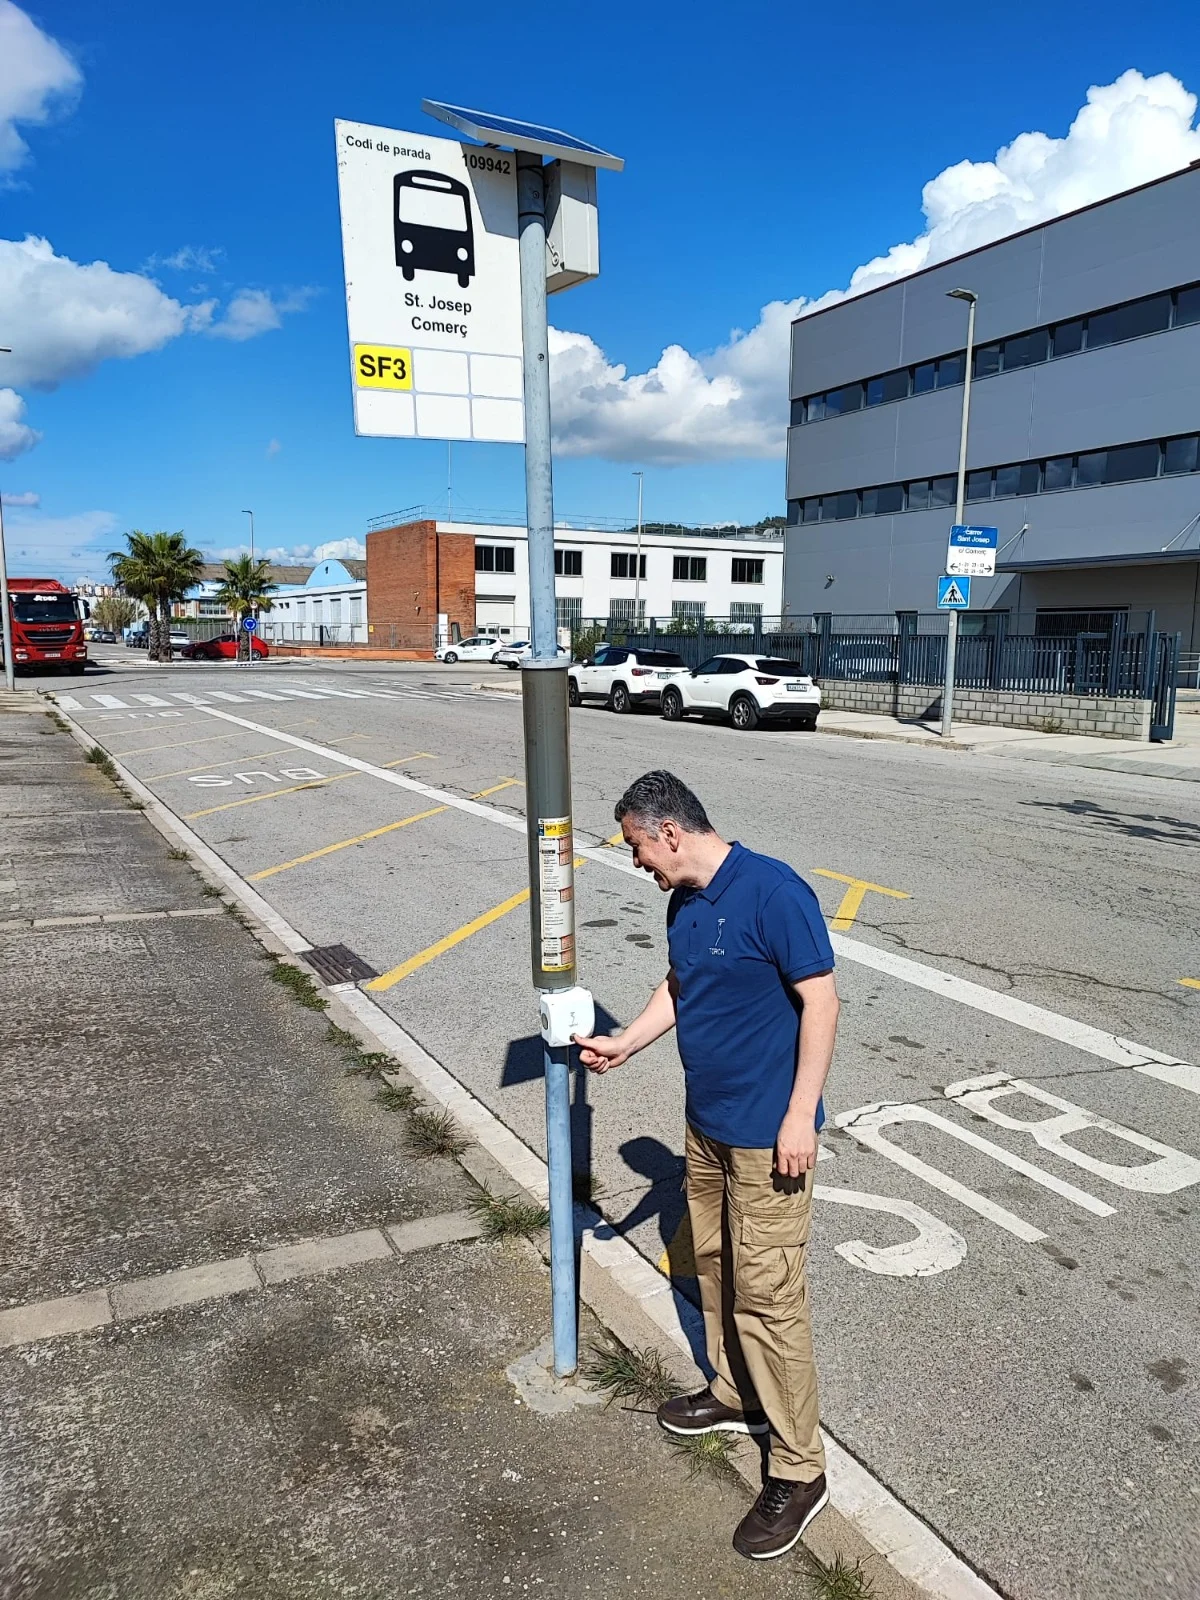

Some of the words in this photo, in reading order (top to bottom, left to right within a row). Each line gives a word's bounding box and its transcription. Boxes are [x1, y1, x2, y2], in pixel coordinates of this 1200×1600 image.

[346, 135, 373, 150] Codi
[376, 141, 390, 153] de
[393, 146, 431, 161] parada
[462, 153, 511, 175] 109942
[404, 292, 424, 308] St.
[429, 295, 472, 316] Josep
[411, 316, 468, 338] Comerç
[359, 354, 406, 380] SF3
[972, 536, 990, 544] Josep
[187, 767, 328, 788] BUS
